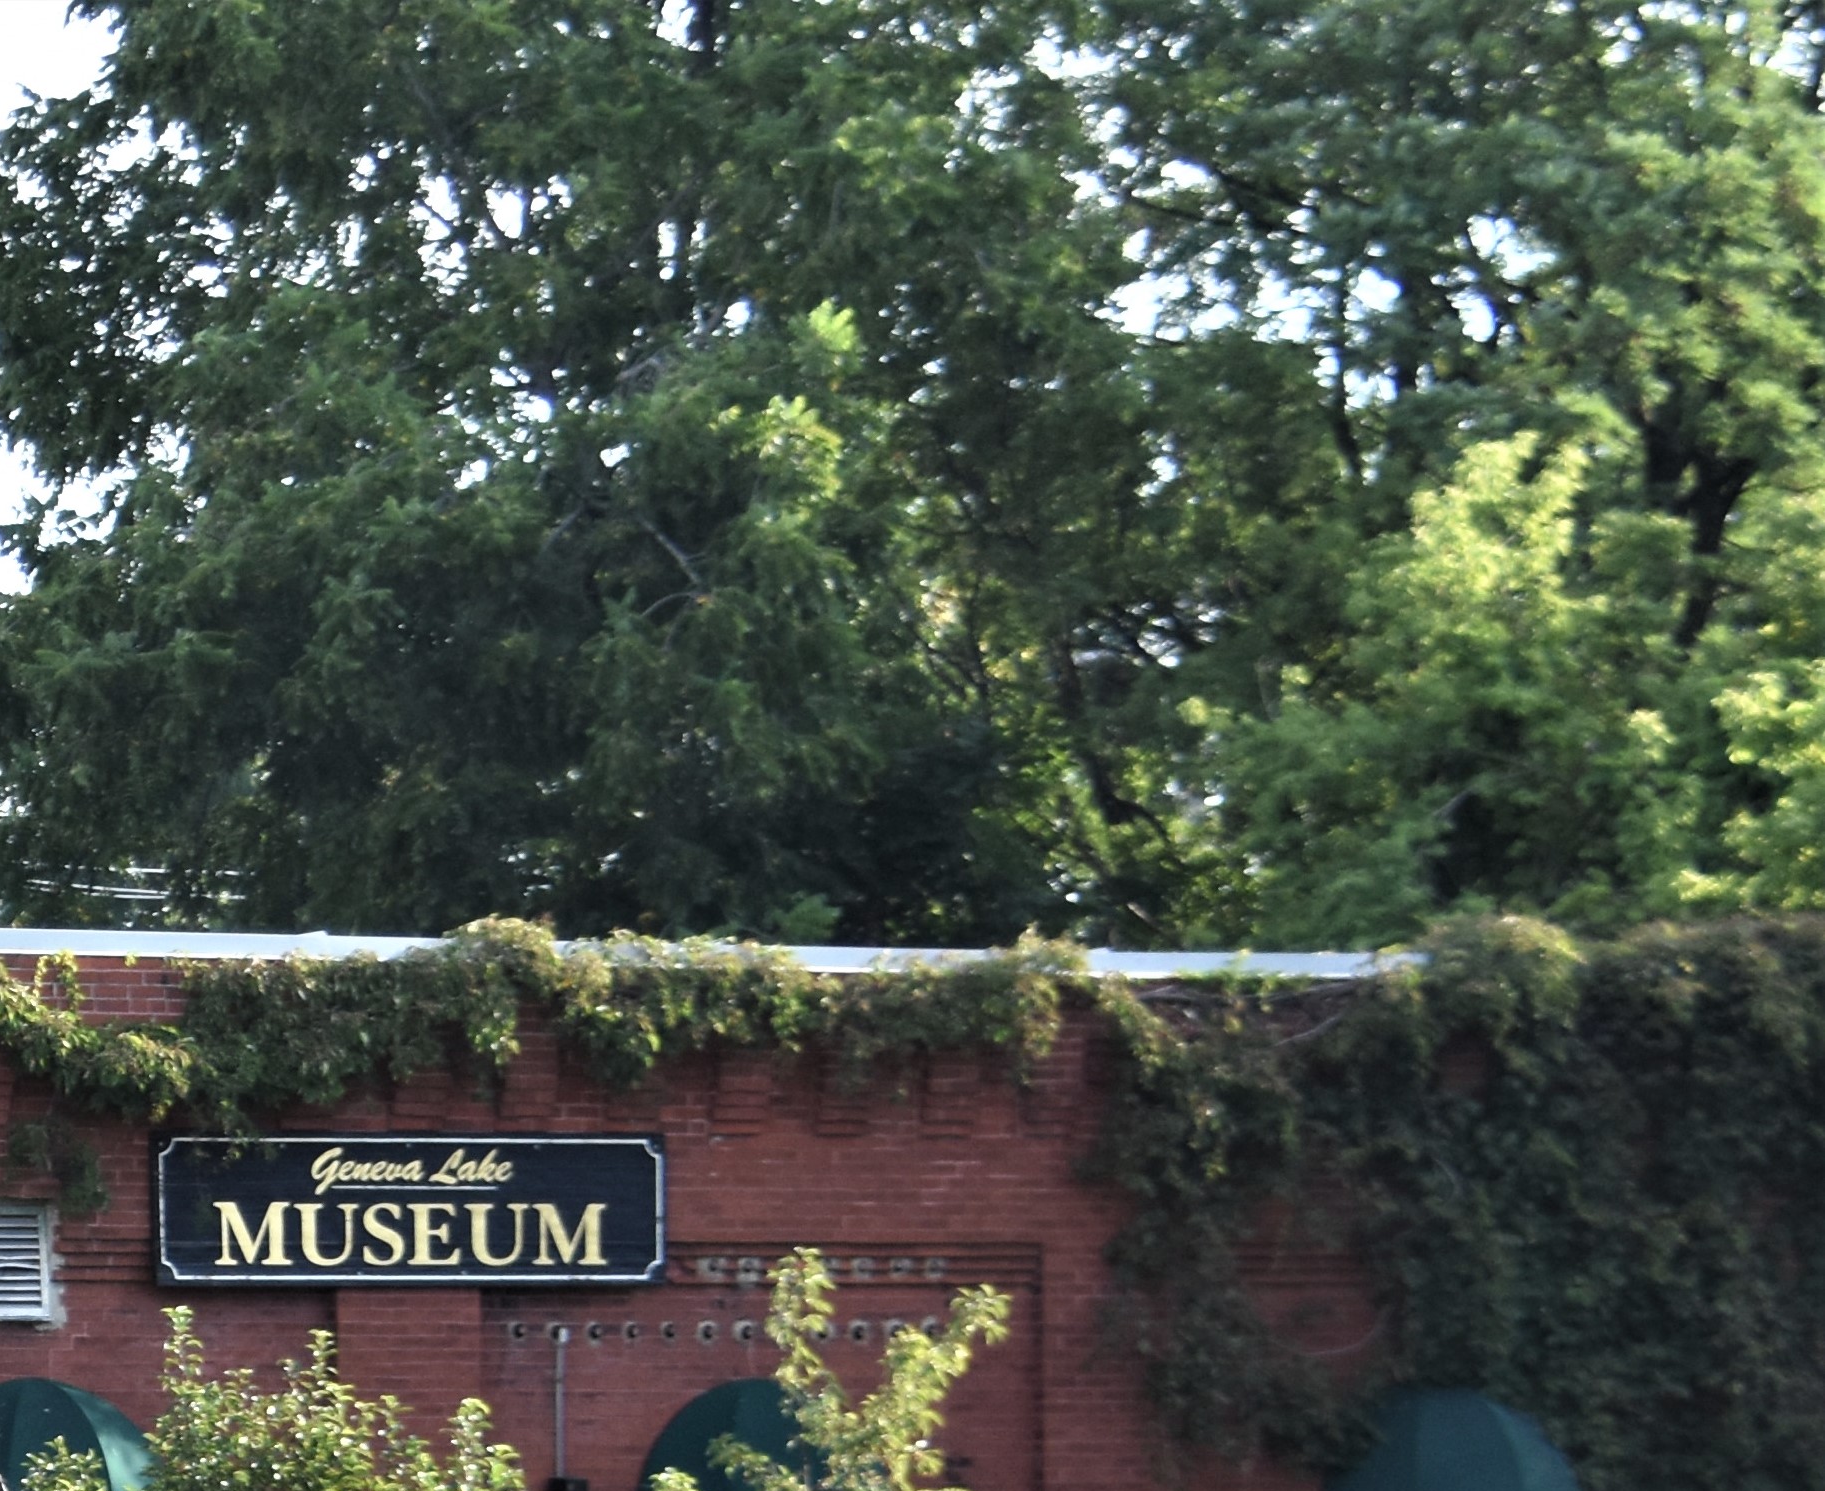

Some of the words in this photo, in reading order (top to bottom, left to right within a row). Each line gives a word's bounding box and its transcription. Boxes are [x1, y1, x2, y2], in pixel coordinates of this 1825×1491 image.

[311, 1147, 425, 1195] Geneva
[428, 1149, 514, 1184] Lake
[213, 1201, 608, 1266] MUSEUM
